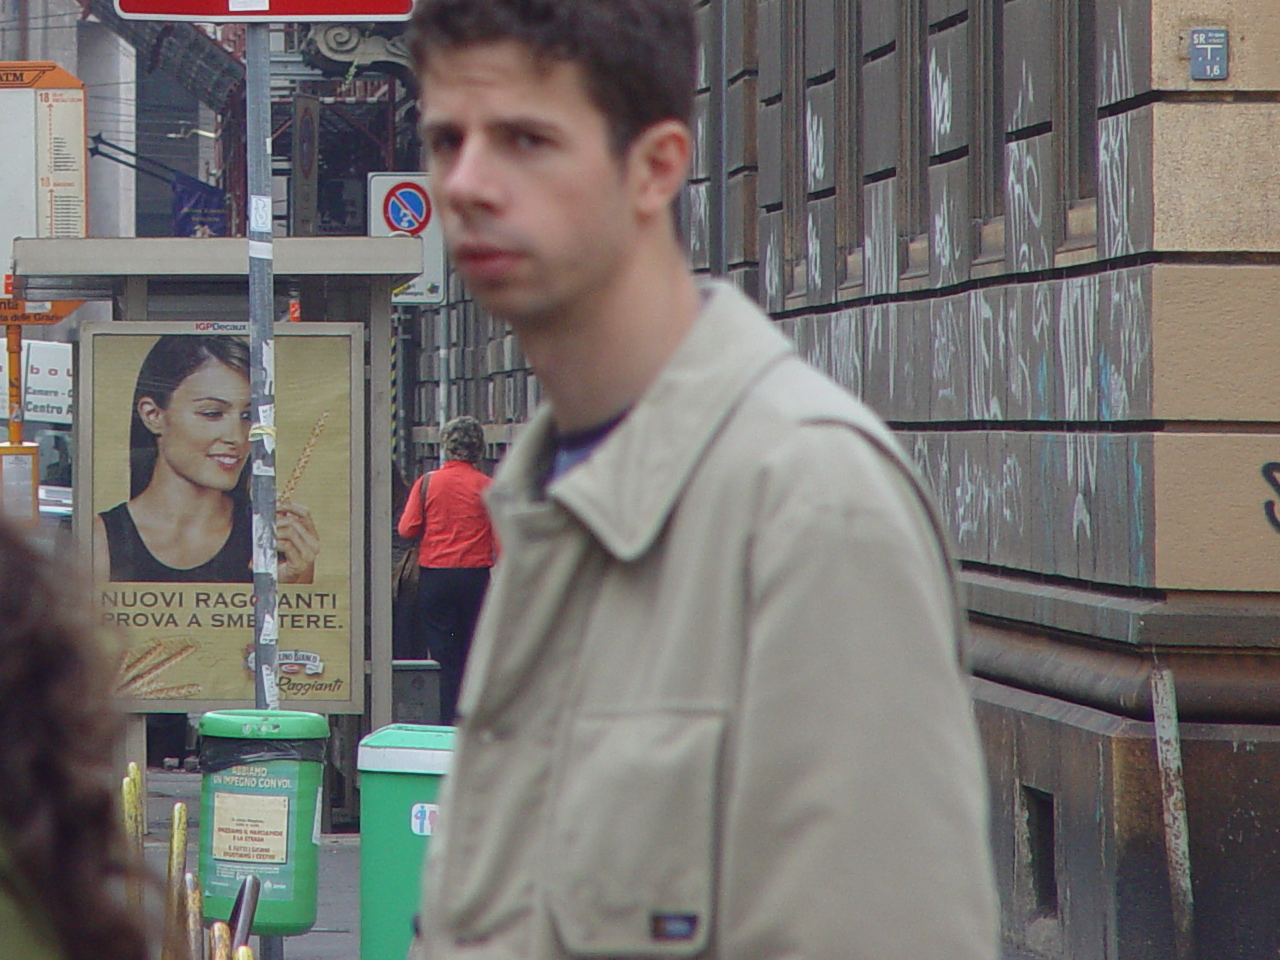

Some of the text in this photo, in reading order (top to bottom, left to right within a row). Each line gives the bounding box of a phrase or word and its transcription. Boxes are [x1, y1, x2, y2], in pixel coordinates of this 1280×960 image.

[1193, 33, 1206, 44] SR
[1205, 64, 1221, 77] 1,6
[11, 314, 30, 322] delle
[195, 322, 247, 331] IGPDecaux
[25, 400, 63, 415] Centro
[101, 592, 183, 608] NUOVI
[104, 612, 179, 628] PROVA
[186, 614, 202, 628] A
[275, 675, 344, 696] Raggianti
[232, 766, 268, 777] ABBIAMO
[223, 776, 257, 788] IMPEGNO
